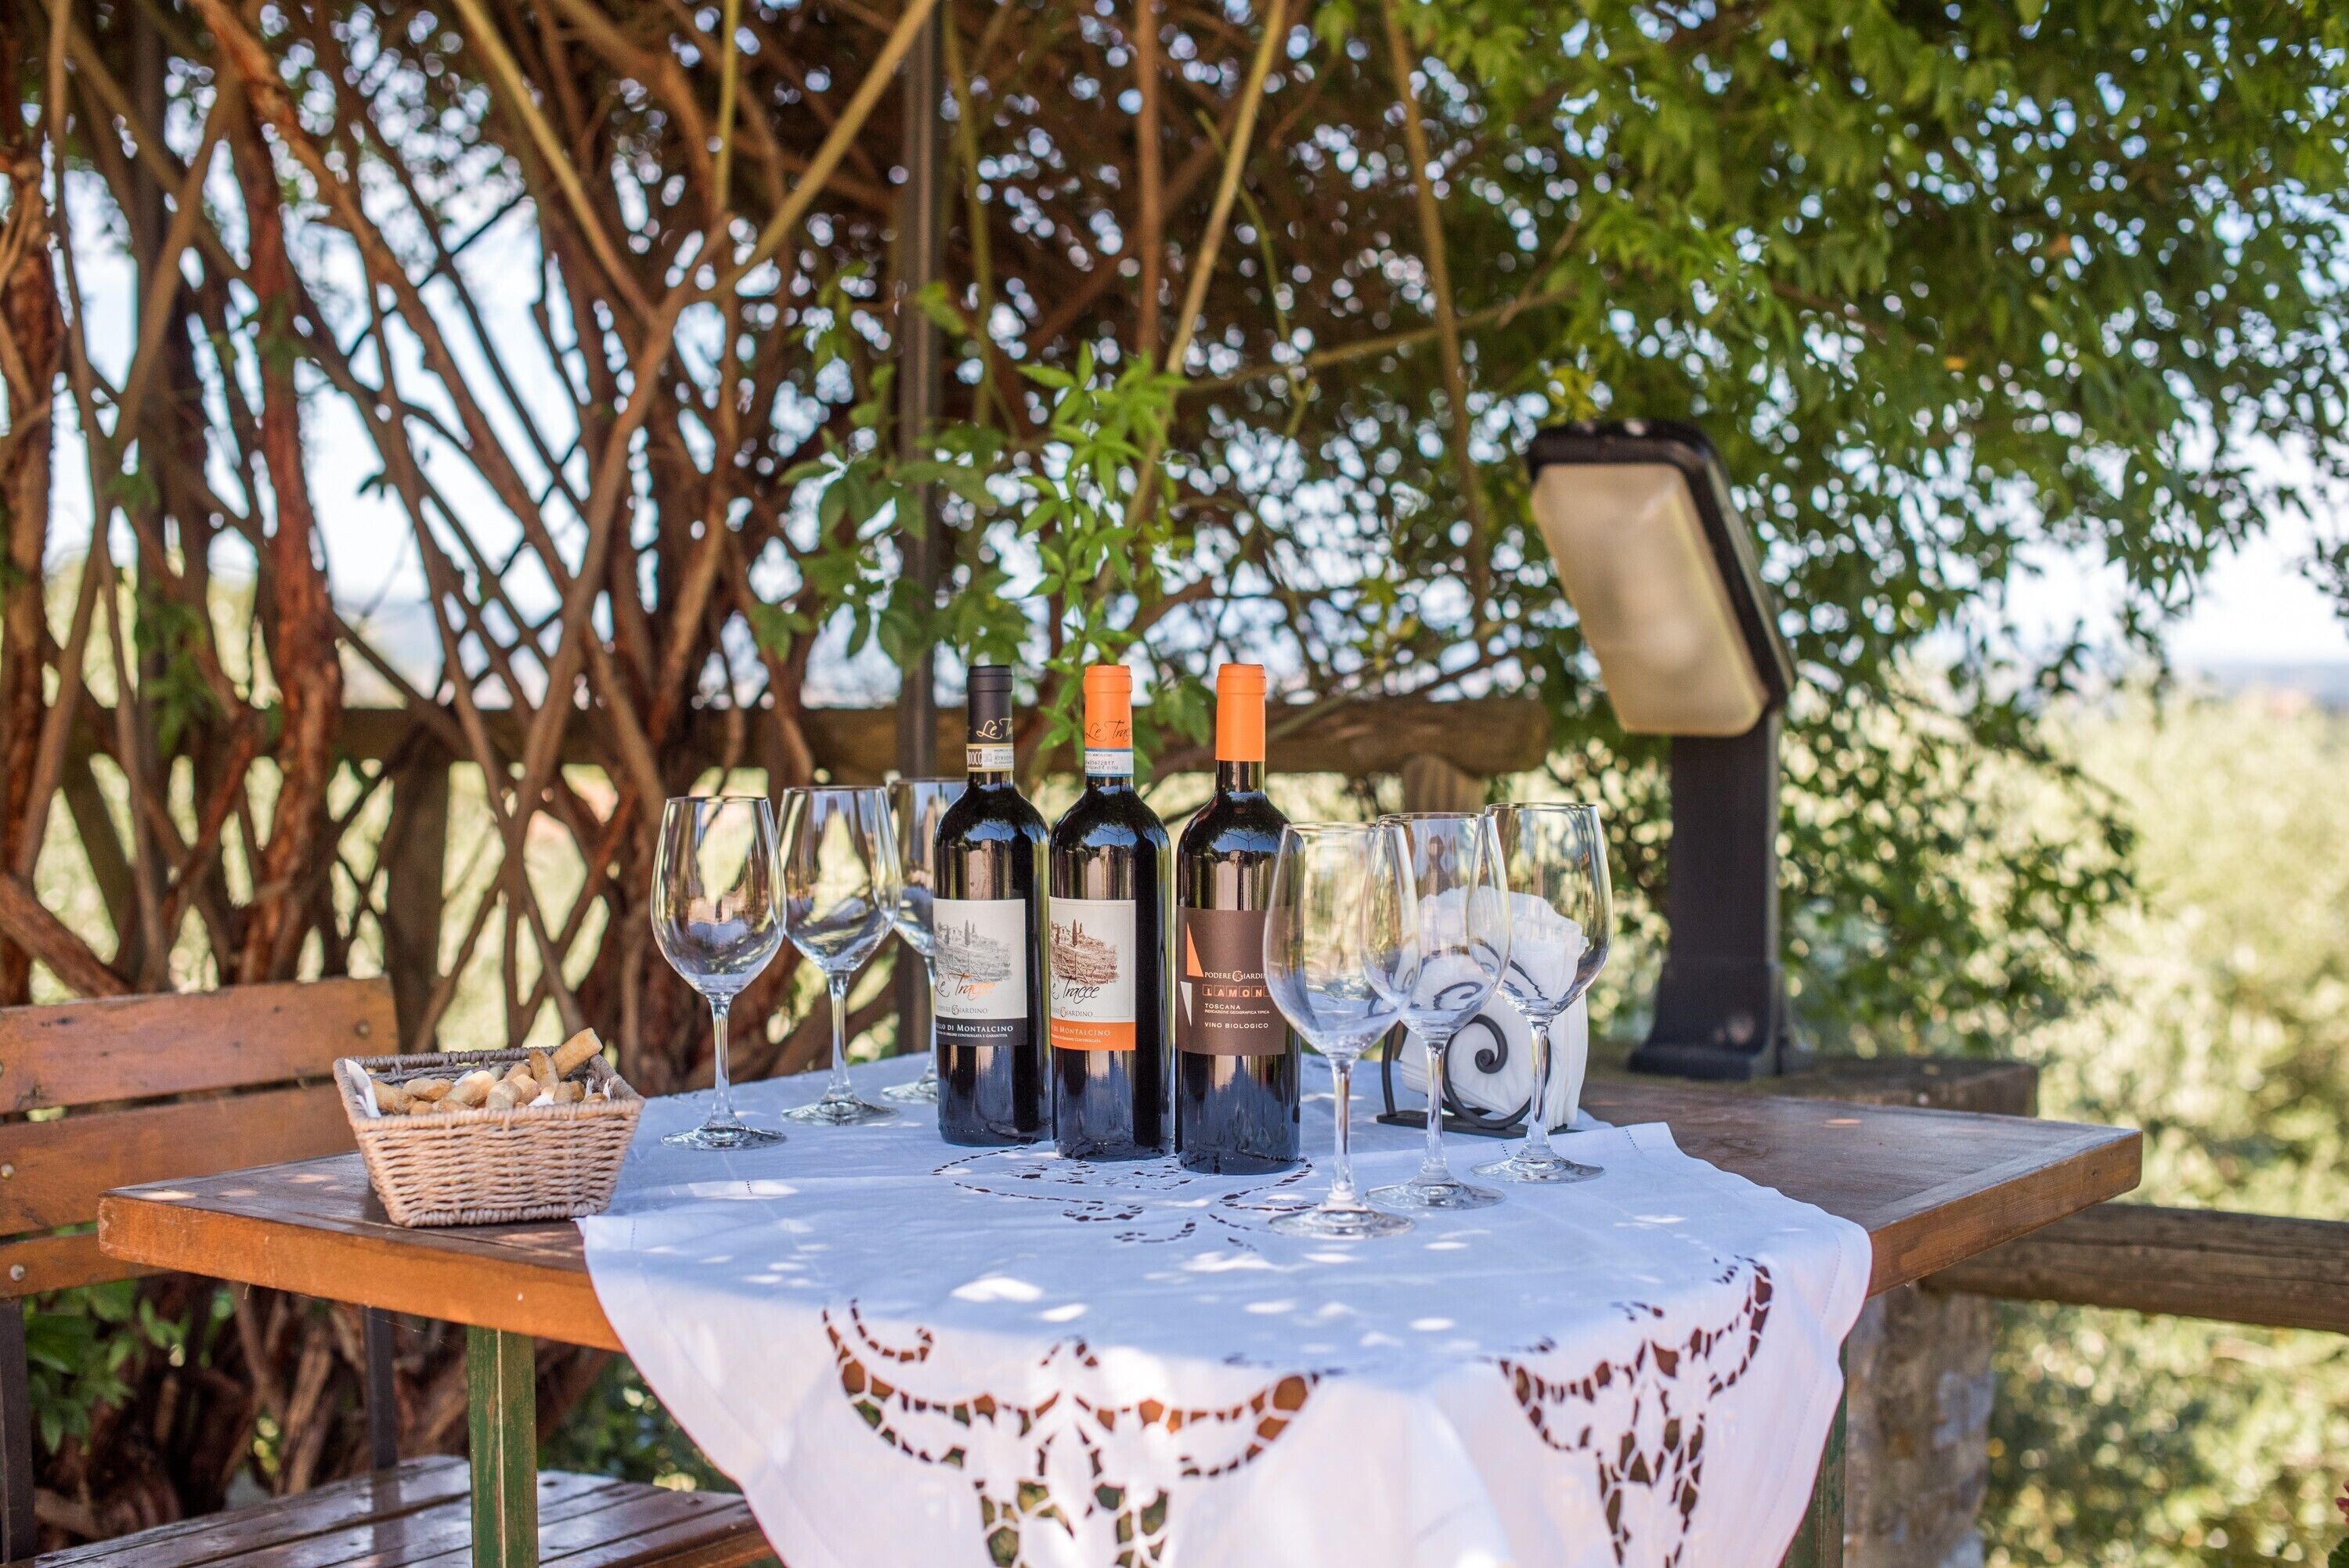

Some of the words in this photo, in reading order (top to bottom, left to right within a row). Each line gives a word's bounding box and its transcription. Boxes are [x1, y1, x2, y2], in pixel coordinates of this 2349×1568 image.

[976, 719, 1003, 740] Le
[1085, 722, 1107, 742] Le
[1057, 975, 1100, 1004] Tracce
[1207, 988, 1262, 997] LAMON
[951, 1004, 988, 1016] GIARDINO
[1060, 1006, 1093, 1018] GIARDINO
[957, 1024, 1013, 1033] MONTALCINO
[1059, 1026, 1111, 1036] MONTALCINO
